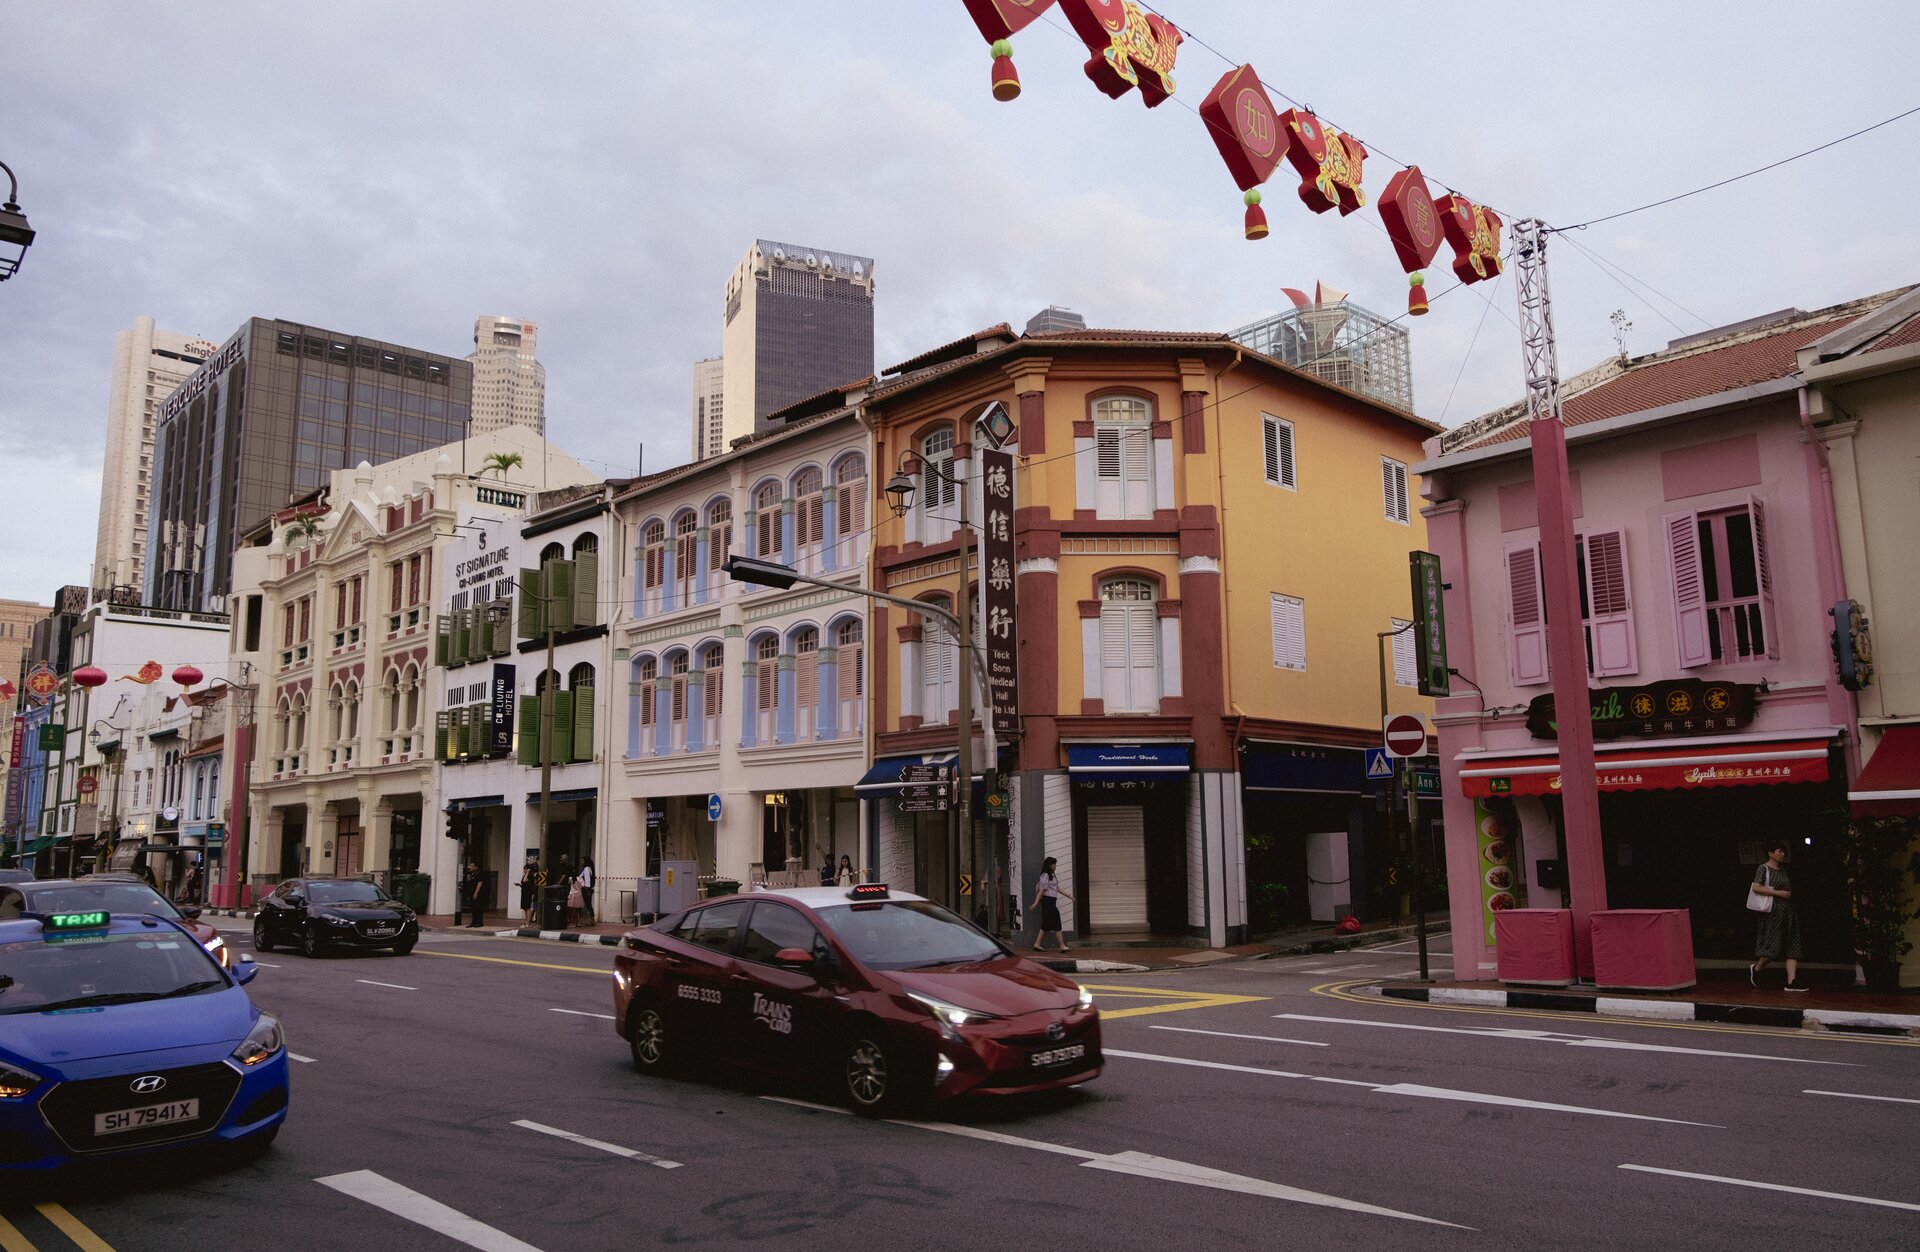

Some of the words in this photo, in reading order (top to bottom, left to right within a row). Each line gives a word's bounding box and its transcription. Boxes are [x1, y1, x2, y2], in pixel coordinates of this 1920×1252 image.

[1244, 97, 1268, 143] 如
[1413, 198, 1431, 235] 意
[160, 370, 207, 427] MERCURE
[208, 333, 246, 383] HOTEL
[456, 562, 466, 577] ST
[467, 546, 509, 573] SIGNATURE
[459, 571, 486, 589] CO-LIVING
[487, 565, 504, 579] HOTEL
[993, 650, 1010, 660] Teck
[992, 662, 1011, 674] Soon
[495, 678, 505, 724] CO-LIVING
[505, 688, 513, 716] HOTEL
[995, 691, 1009, 700] Hall
[1591, 691, 1625, 721] zik
[1004, 706, 1016, 715] Ltd
[1643, 717, 1737, 733] 兰州牛肉面
[1417, 775, 1434, 788] Ann
[52, 912, 103, 927] TAXI
[678, 983, 699, 1000] 6555
[700, 987, 722, 1004] 3333
[769, 1018, 792, 1034] cab
[105, 1111, 130, 1130] SH
[134, 1105, 176, 1125] 7941
[180, 1102, 191, 1118] X
